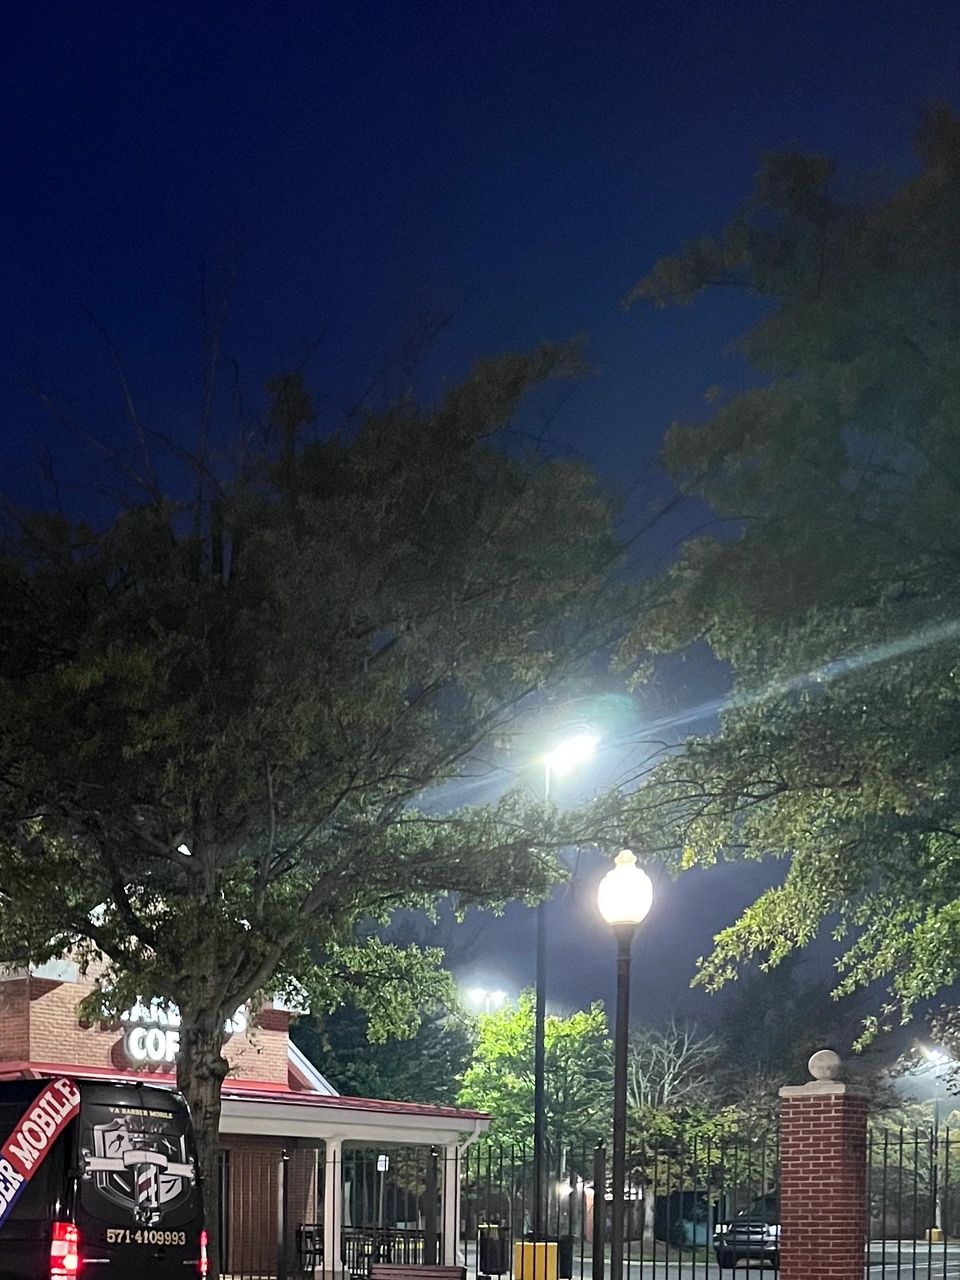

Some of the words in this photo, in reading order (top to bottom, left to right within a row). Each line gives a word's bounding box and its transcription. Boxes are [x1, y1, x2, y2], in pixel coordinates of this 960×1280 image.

[8, 1077, 81, 1170] MOBILE
[109, 1106, 120, 1114] VA
[121, 1108, 148, 1116] BARBER
